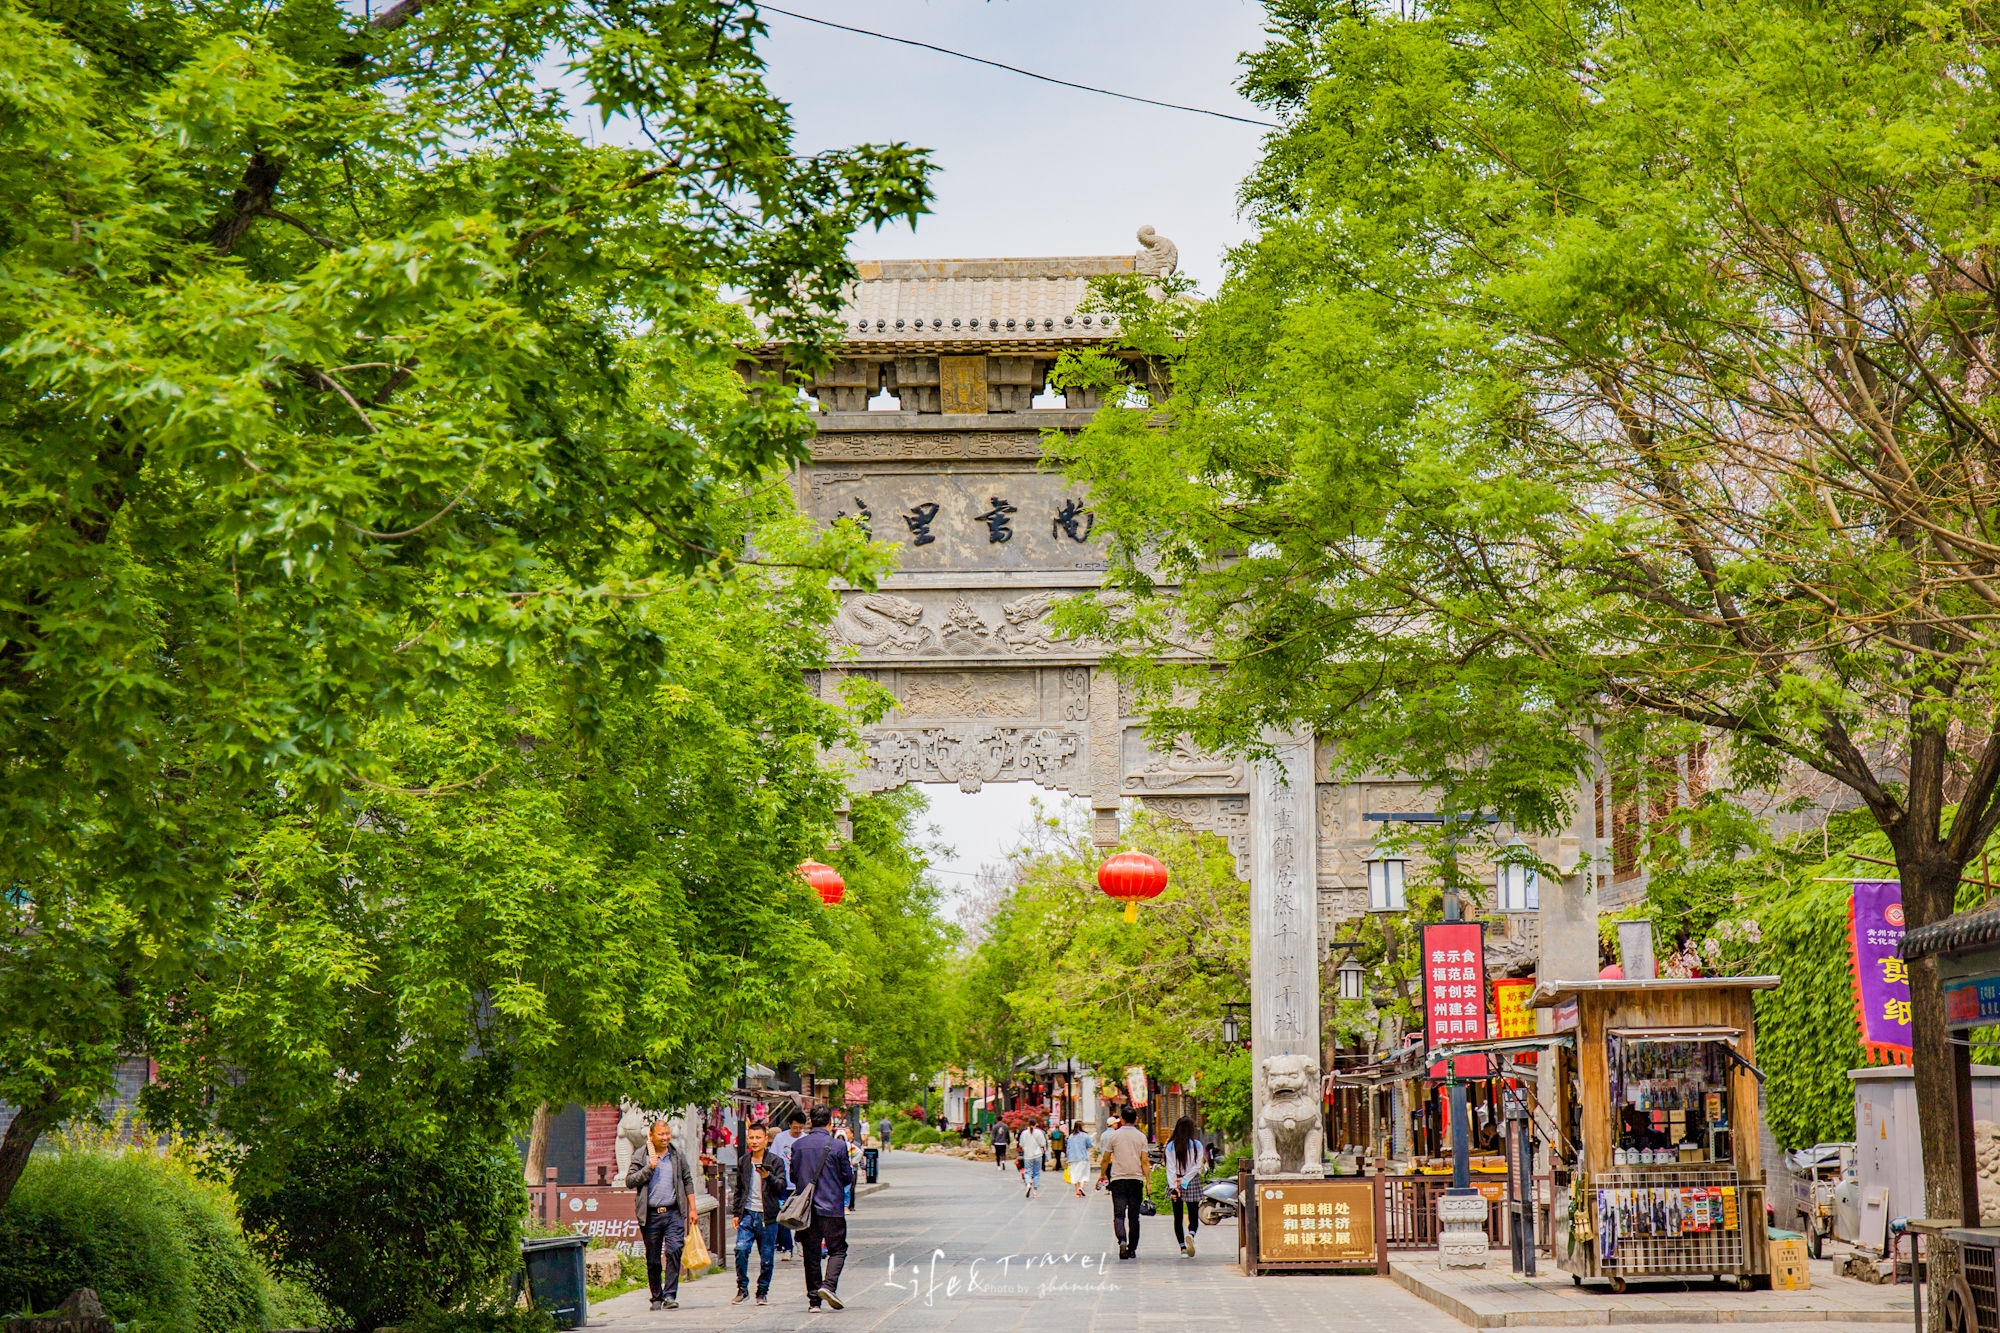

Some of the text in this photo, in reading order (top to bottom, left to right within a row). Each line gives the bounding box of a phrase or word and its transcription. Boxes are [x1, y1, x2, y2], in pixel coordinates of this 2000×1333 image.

[1462, 949, 1478, 1042] 食品安全同
[1283, 1202, 1350, 1215] 和睦相处
[572, 1219, 640, 1237] 文明出行
[1283, 1217, 1350, 1231] 和衷共济
[1284, 1232, 1350, 1245] 和谐发展
